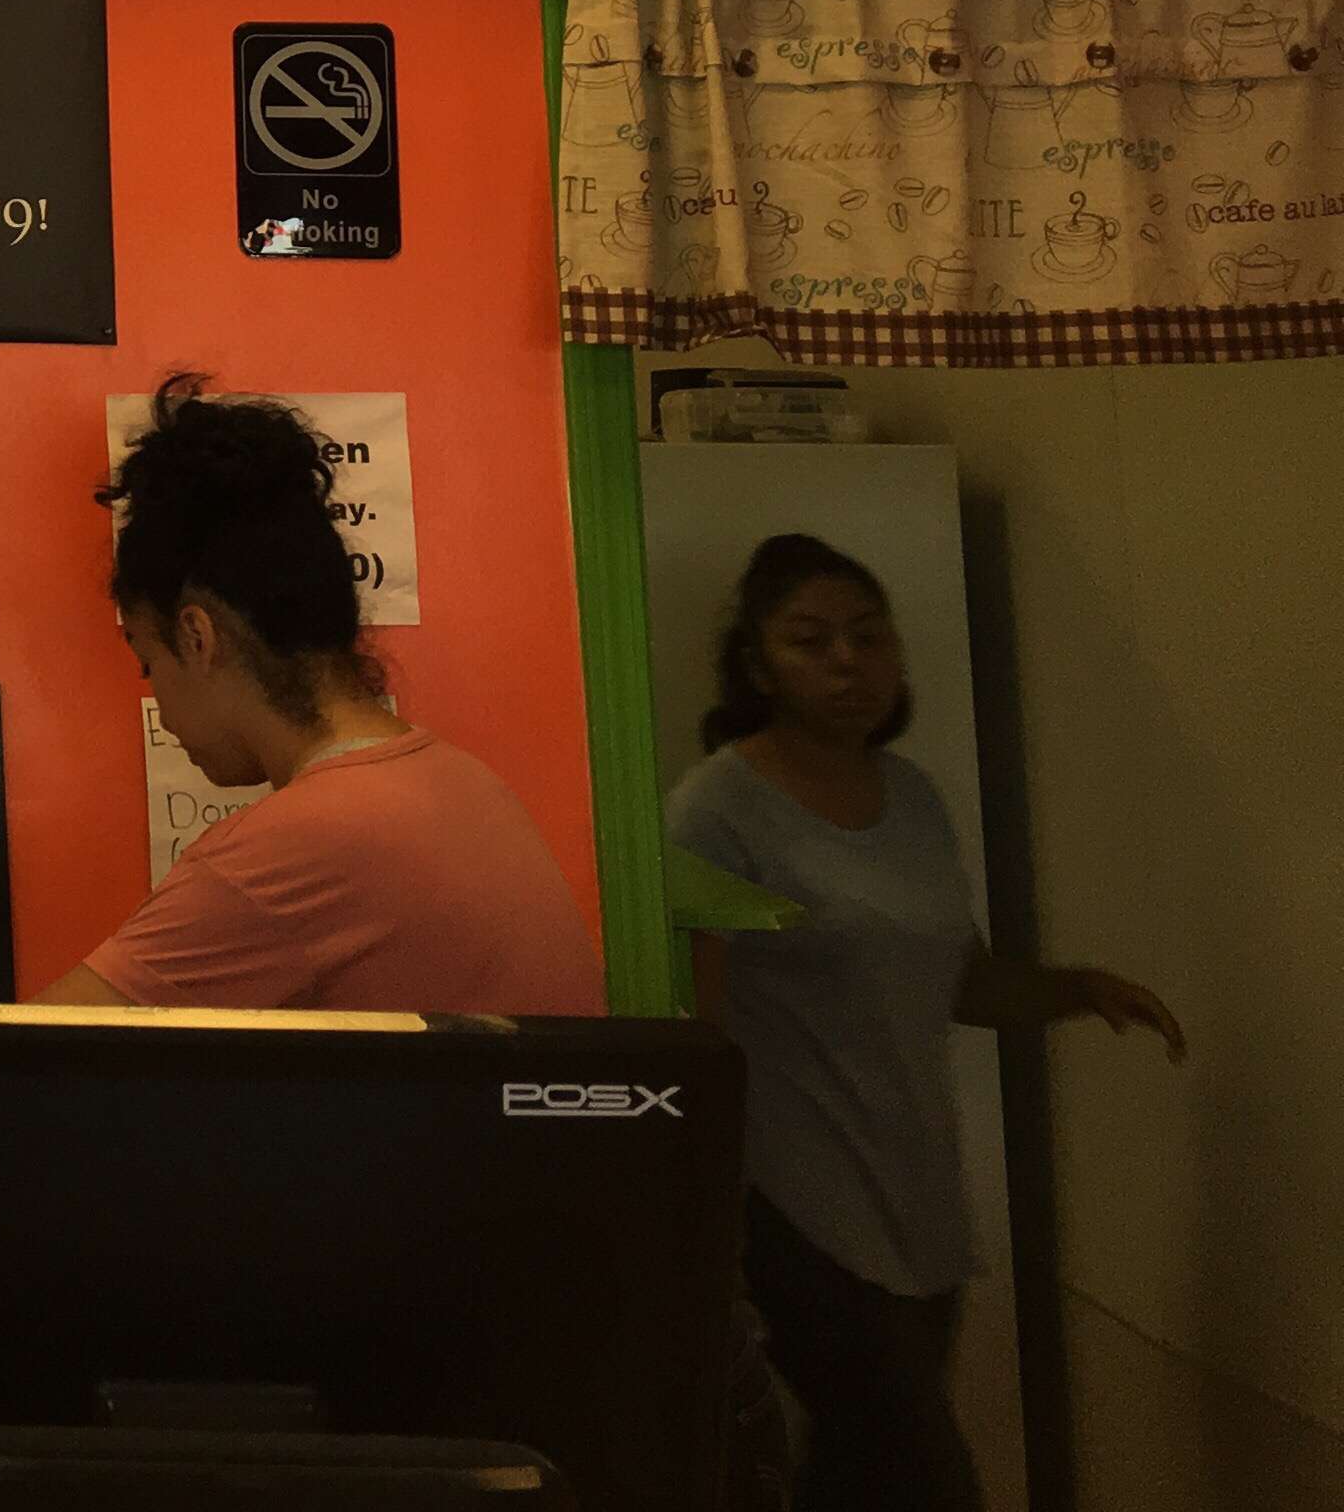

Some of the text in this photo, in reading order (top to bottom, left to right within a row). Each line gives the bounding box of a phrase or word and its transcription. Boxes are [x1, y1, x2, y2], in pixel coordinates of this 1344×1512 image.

[302, 189, 339, 210] No
[1208, 197, 1276, 225] cafe
[291, 221, 379, 248] oking
